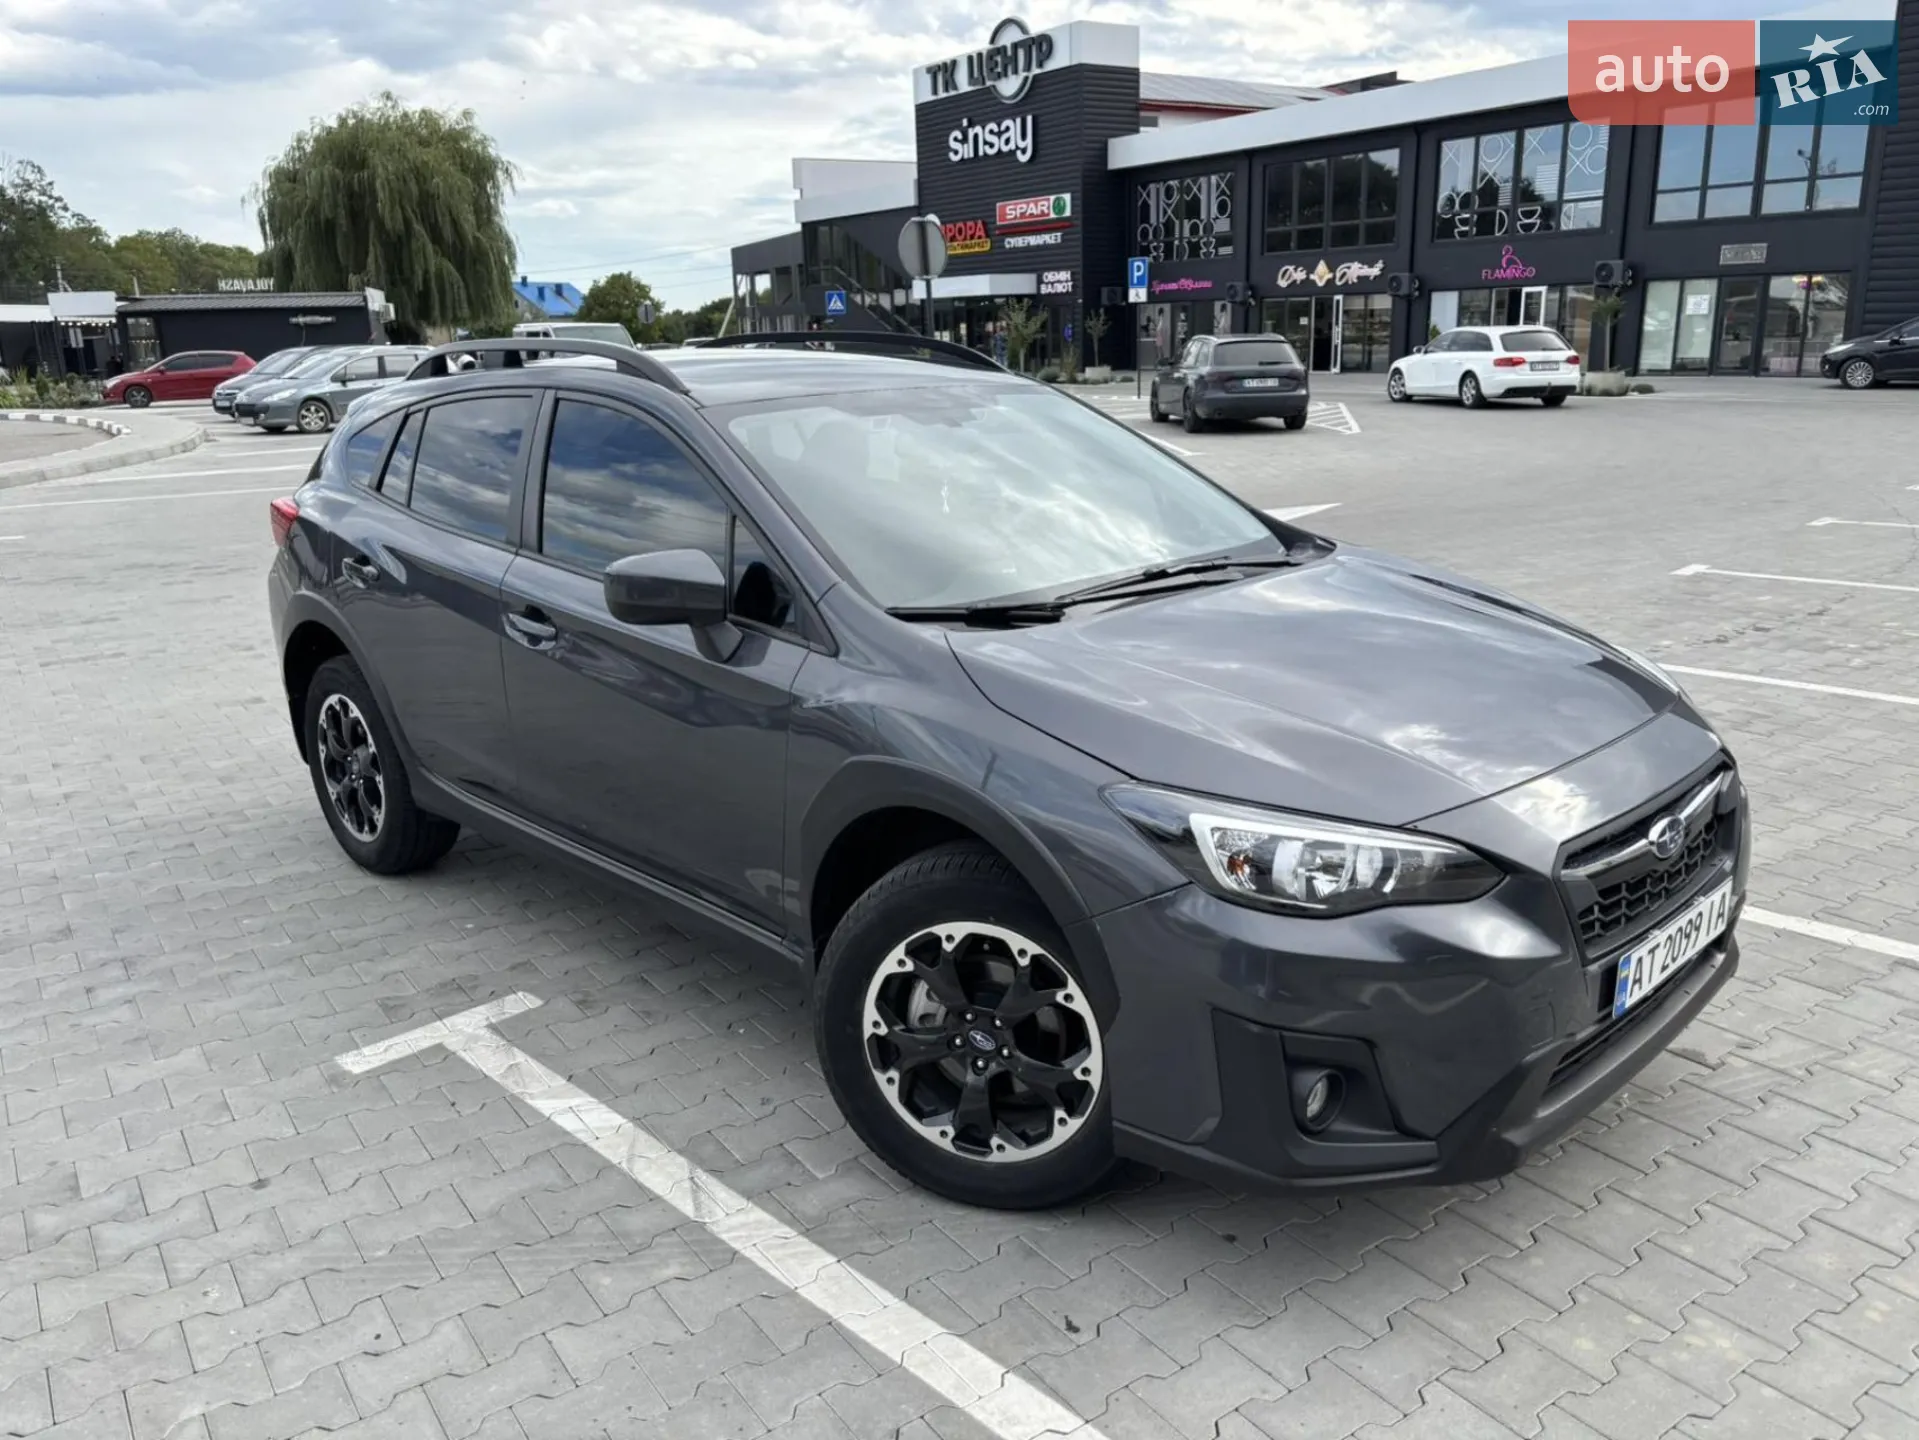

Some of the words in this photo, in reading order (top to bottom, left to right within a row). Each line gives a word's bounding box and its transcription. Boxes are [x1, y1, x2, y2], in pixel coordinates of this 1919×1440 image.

[926, 59, 958, 96] ТК
[967, 34, 1054, 86] ЦЕНТР
[949, 114, 1033, 163] sinsay
[1005, 202, 1049, 219] SPAR
[1004, 233, 1063, 248] СУПЕРМАРКЕТ
[1133, 261, 1145, 285] P
[1481, 266, 1536, 280] FLAMINGO
[1040, 282, 1073, 295] ВАЛЮТ
[1629, 943, 1660, 999] AT
[1660, 910, 1704, 975] 2099
[1706, 891, 1727, 937] IA
